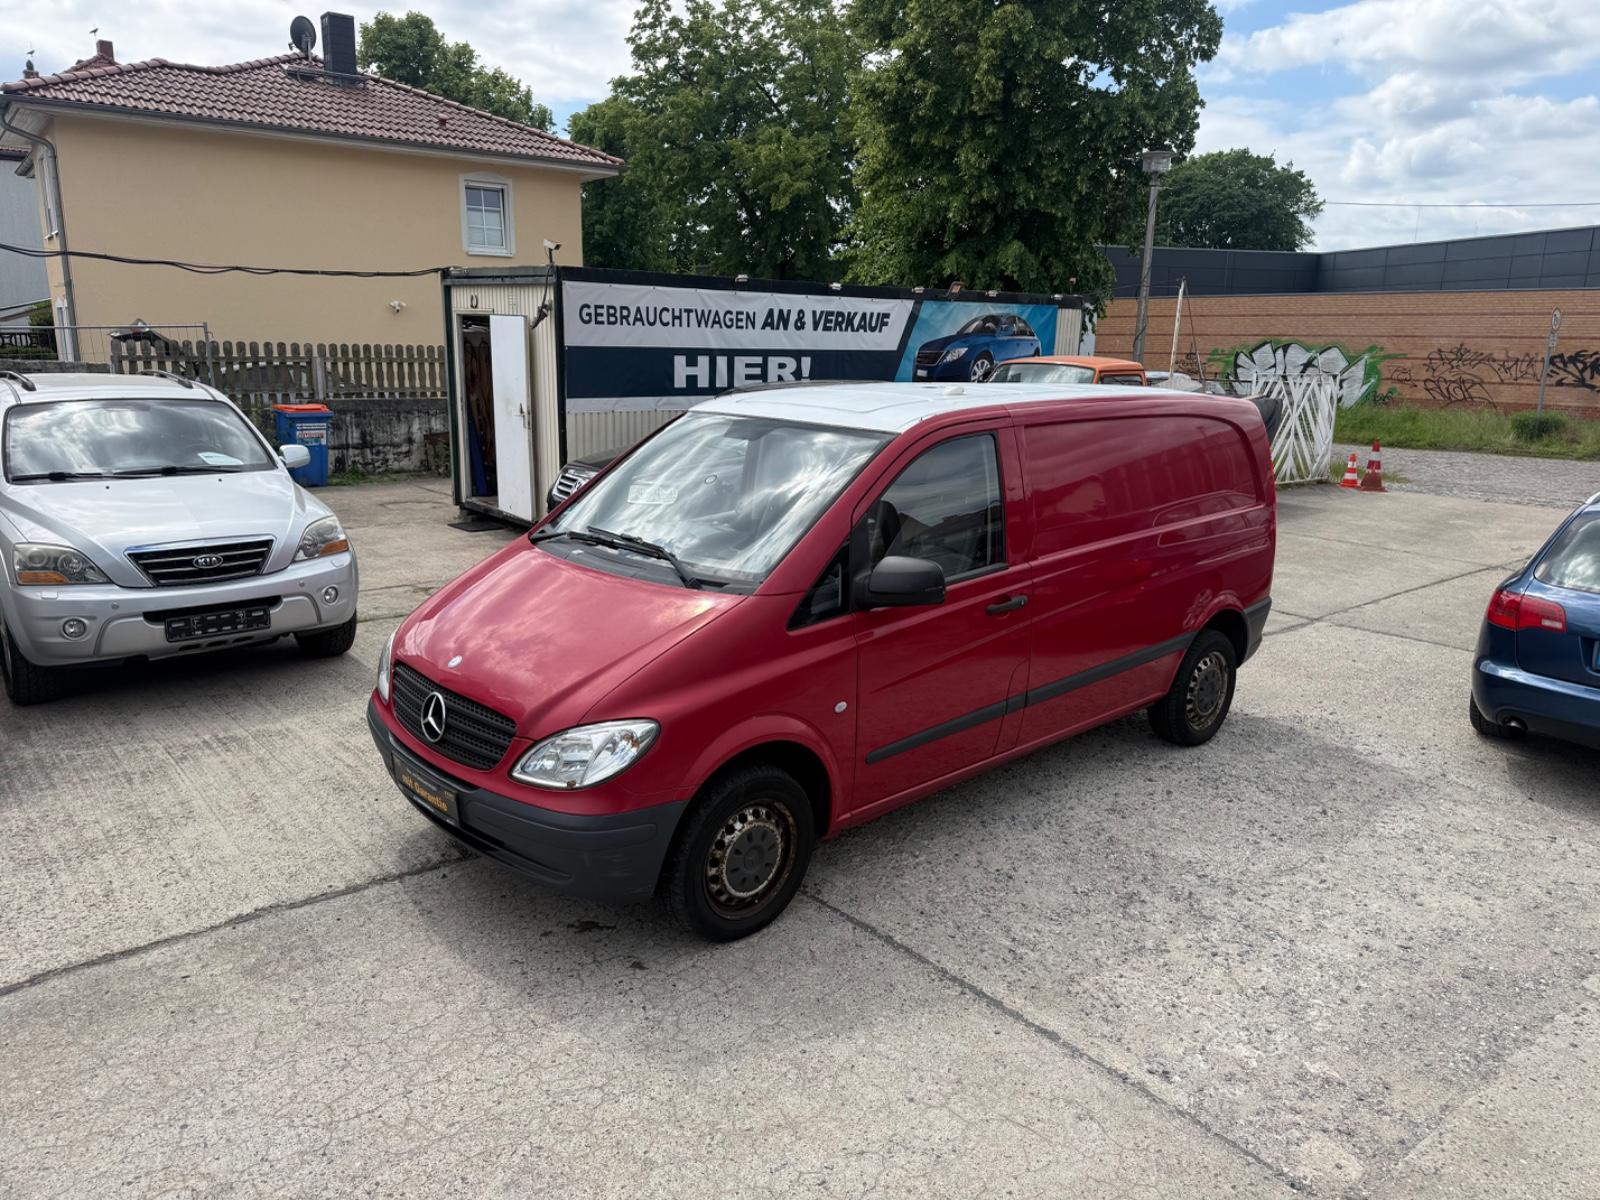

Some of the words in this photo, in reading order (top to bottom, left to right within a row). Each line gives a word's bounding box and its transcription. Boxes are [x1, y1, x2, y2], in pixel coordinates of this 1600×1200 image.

[578, 303, 756, 330] GEBRAUCHTWAGEN
[761, 308, 791, 331] AN
[794, 309, 806, 331] &
[811, 310, 891, 333] VERKAUF
[673, 355, 812, 388] HIER!
[197, 557, 218, 566] KIA
